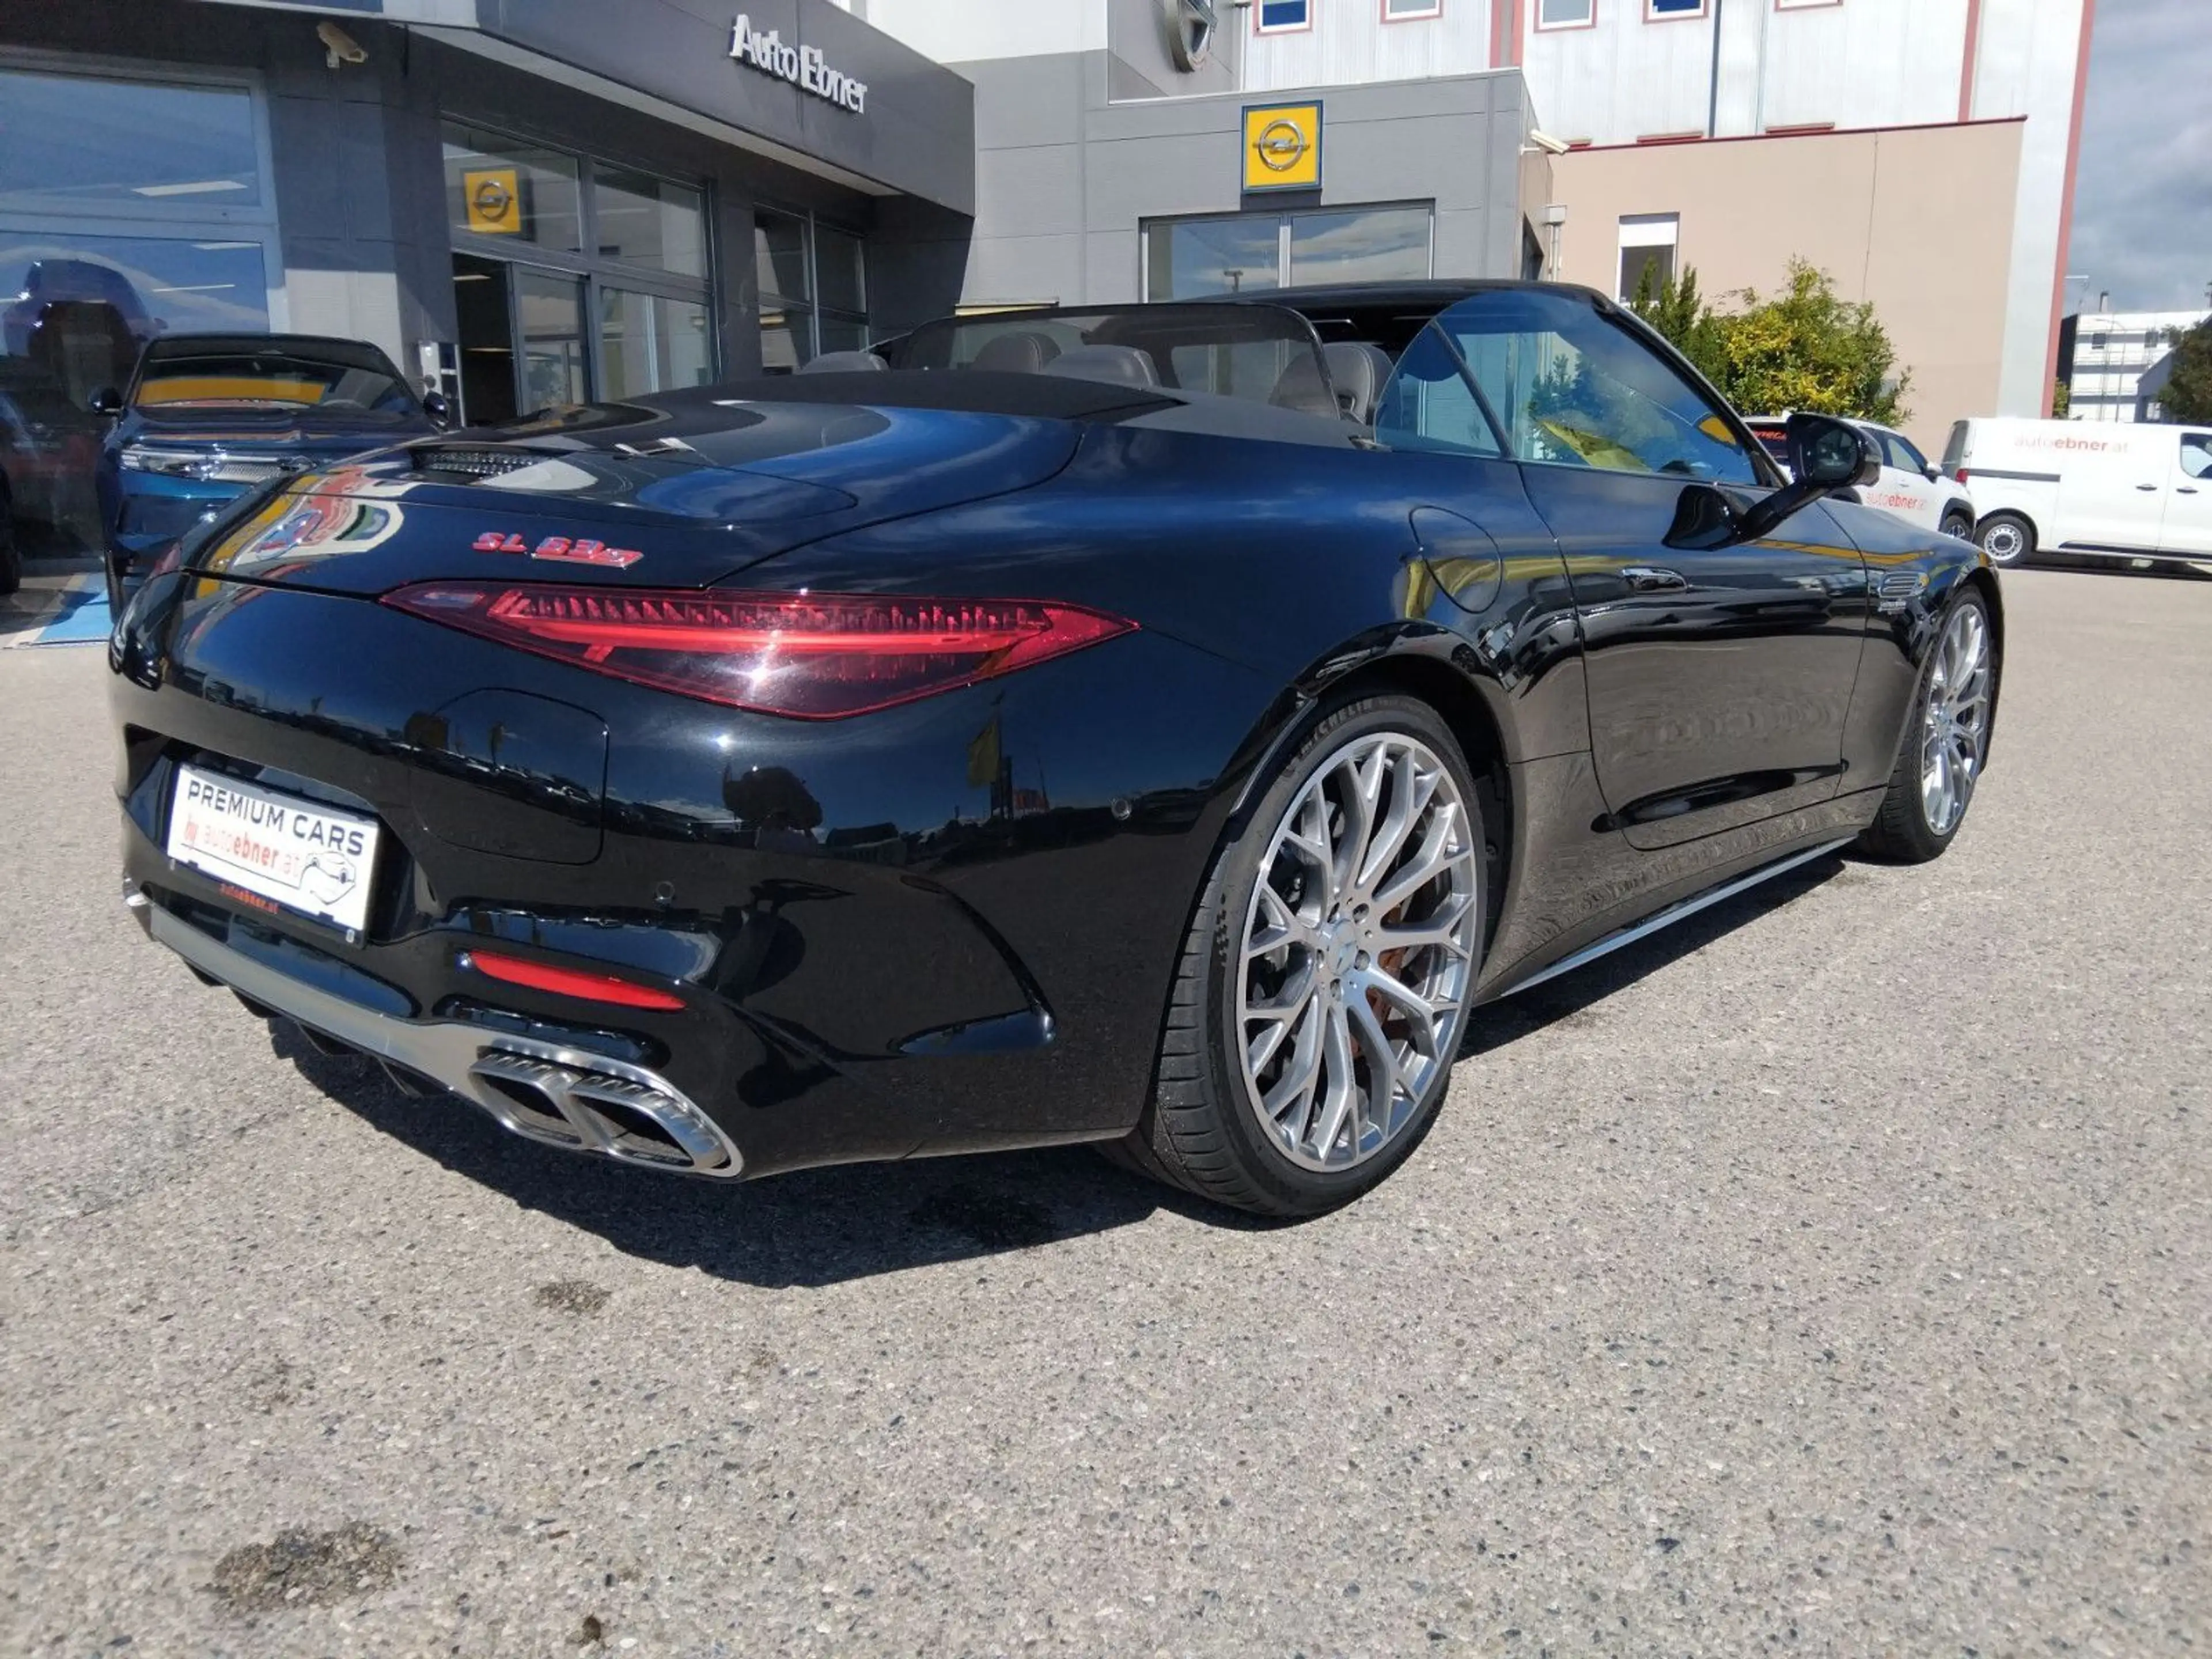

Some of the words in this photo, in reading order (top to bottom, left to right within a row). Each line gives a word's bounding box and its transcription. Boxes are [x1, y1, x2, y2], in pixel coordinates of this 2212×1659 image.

[472, 532, 527, 551] SL
[188, 780, 285, 832] PREMIUM
[293, 813, 365, 857] CARS
